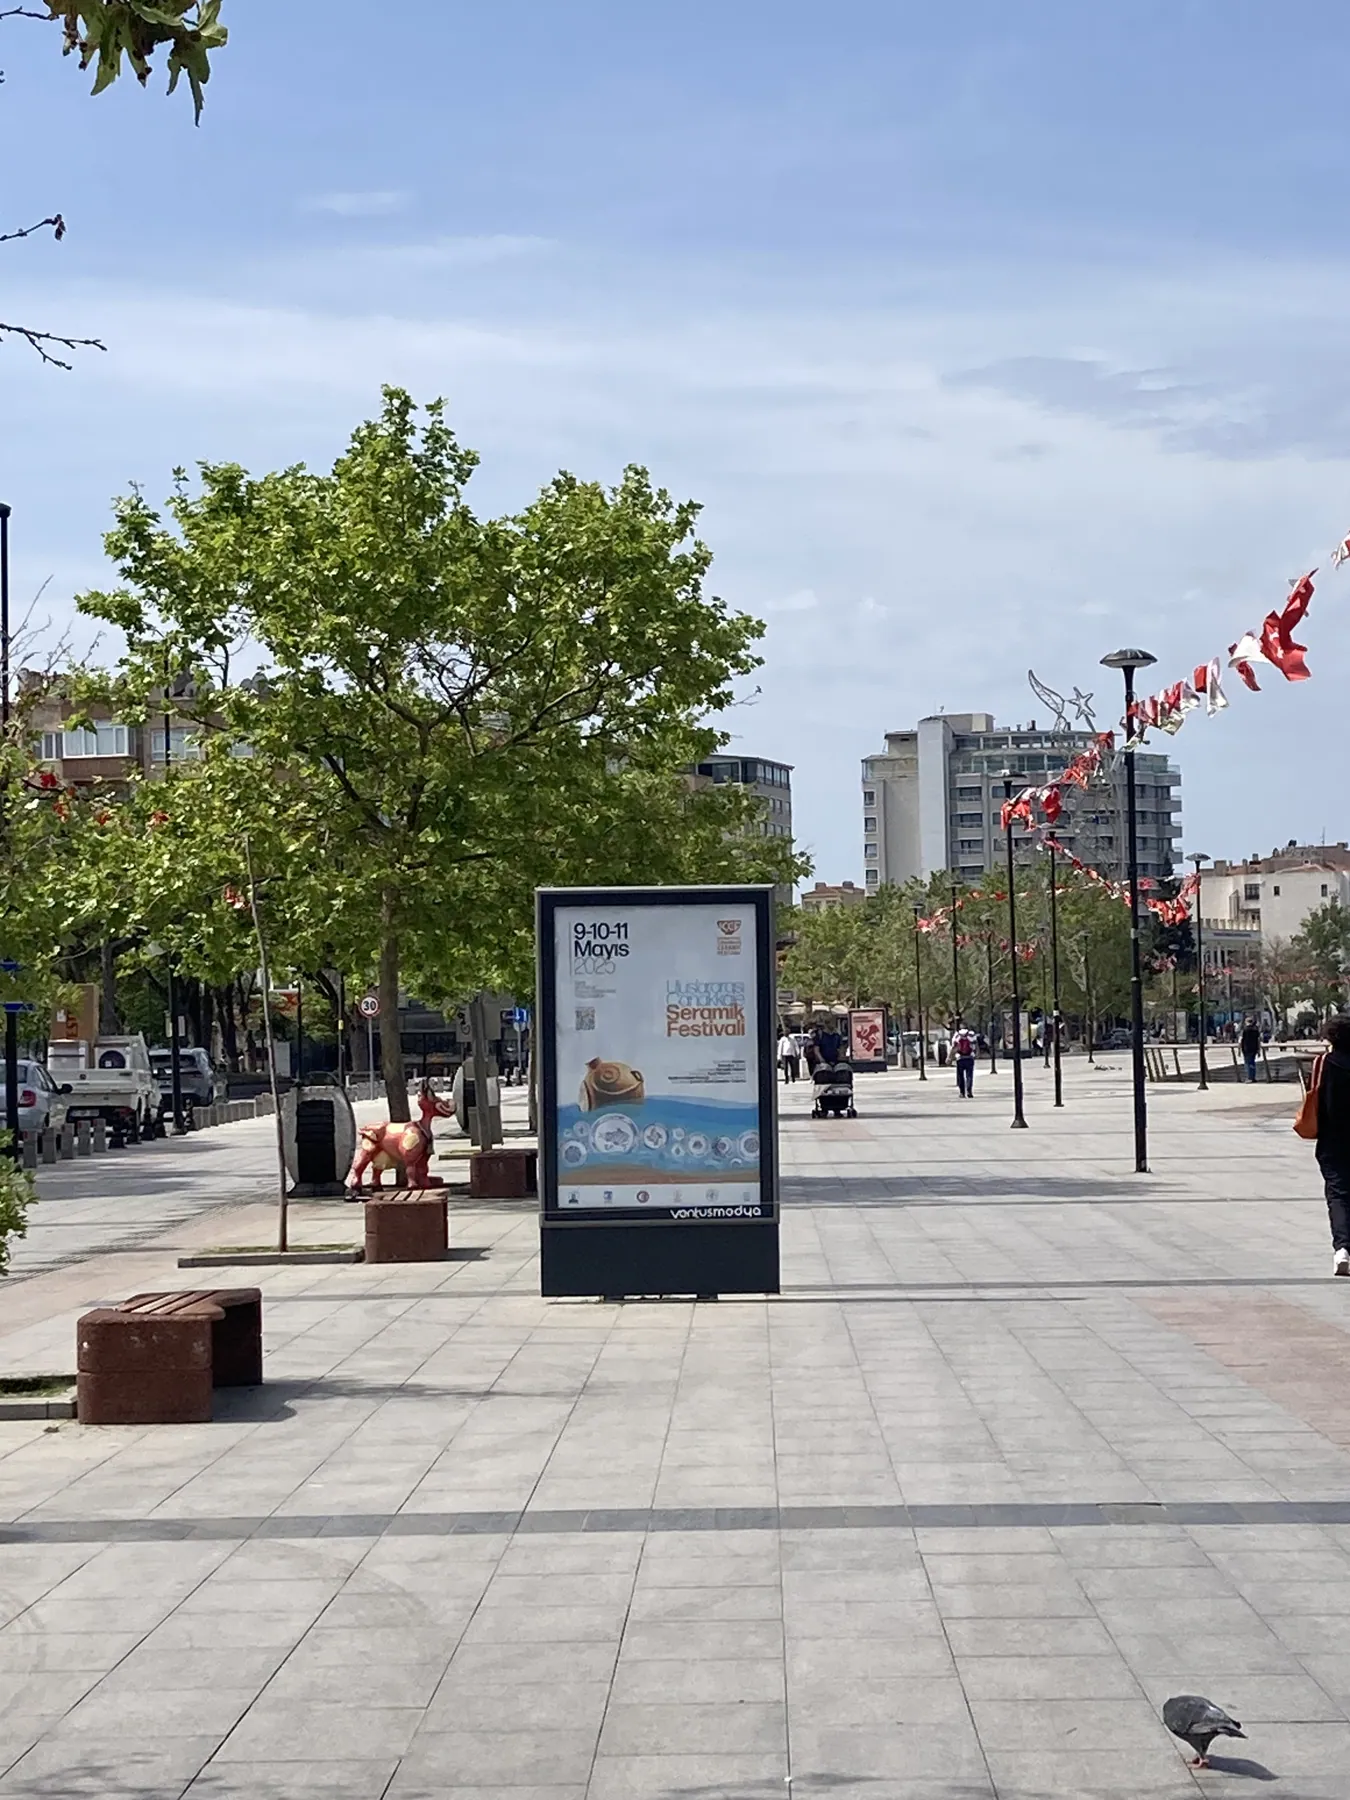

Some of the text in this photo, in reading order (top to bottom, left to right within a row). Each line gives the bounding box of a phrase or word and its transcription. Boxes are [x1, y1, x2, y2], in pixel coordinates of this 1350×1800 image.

[574, 922, 629, 940] 9-10-11
[574, 940, 630, 960] Mayıs
[363, 1000, 377, 1011] 30
[666, 1003, 745, 1021] Seramik
[666, 1019, 745, 1037] Festivali
